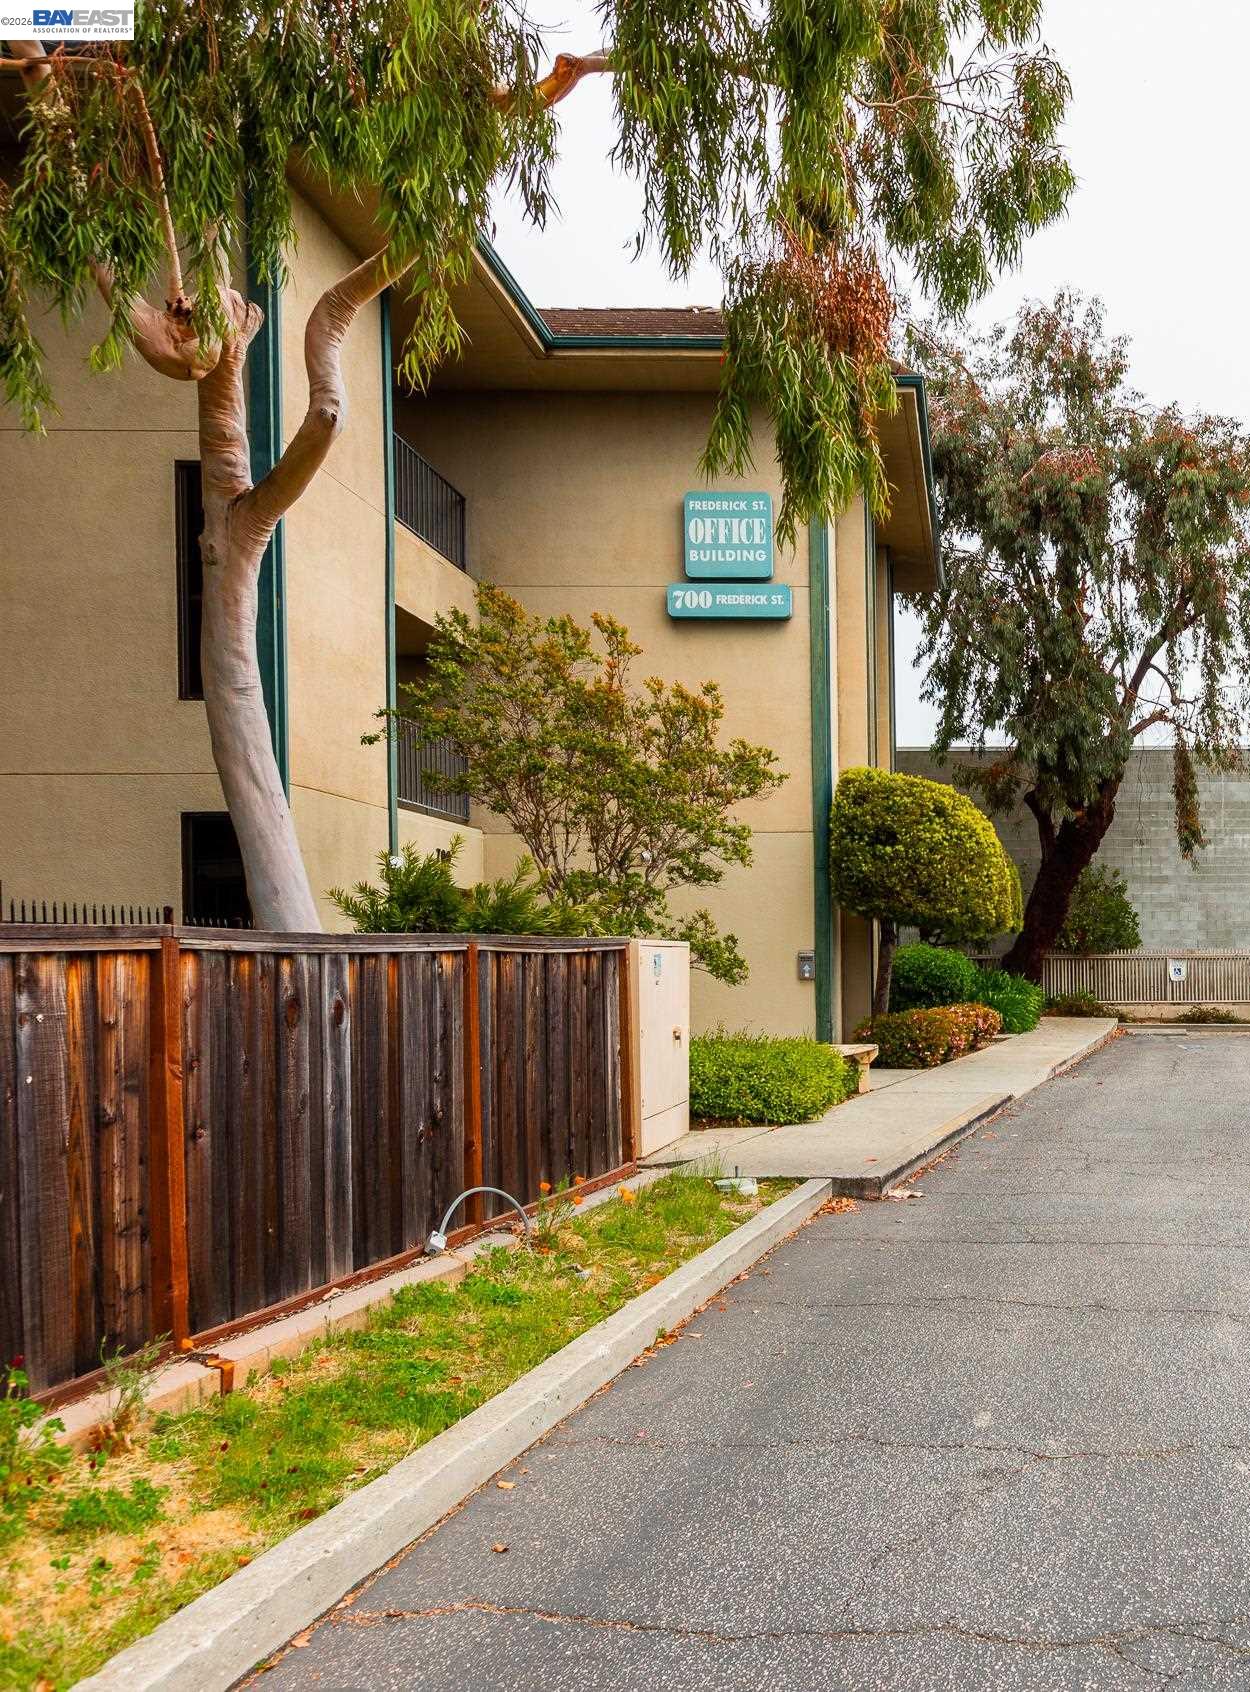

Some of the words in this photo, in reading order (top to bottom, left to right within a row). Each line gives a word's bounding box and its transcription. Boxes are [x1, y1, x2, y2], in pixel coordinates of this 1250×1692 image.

[689, 501, 747, 511] FREDERICK
[752, 501, 767, 511] ST.
[688, 517, 766, 544] OFFICE
[689, 550, 767, 561] BUILDING
[672, 590, 713, 609] 700
[716, 595, 768, 605] FREDERICK
[771, 595, 784, 605] ST.
